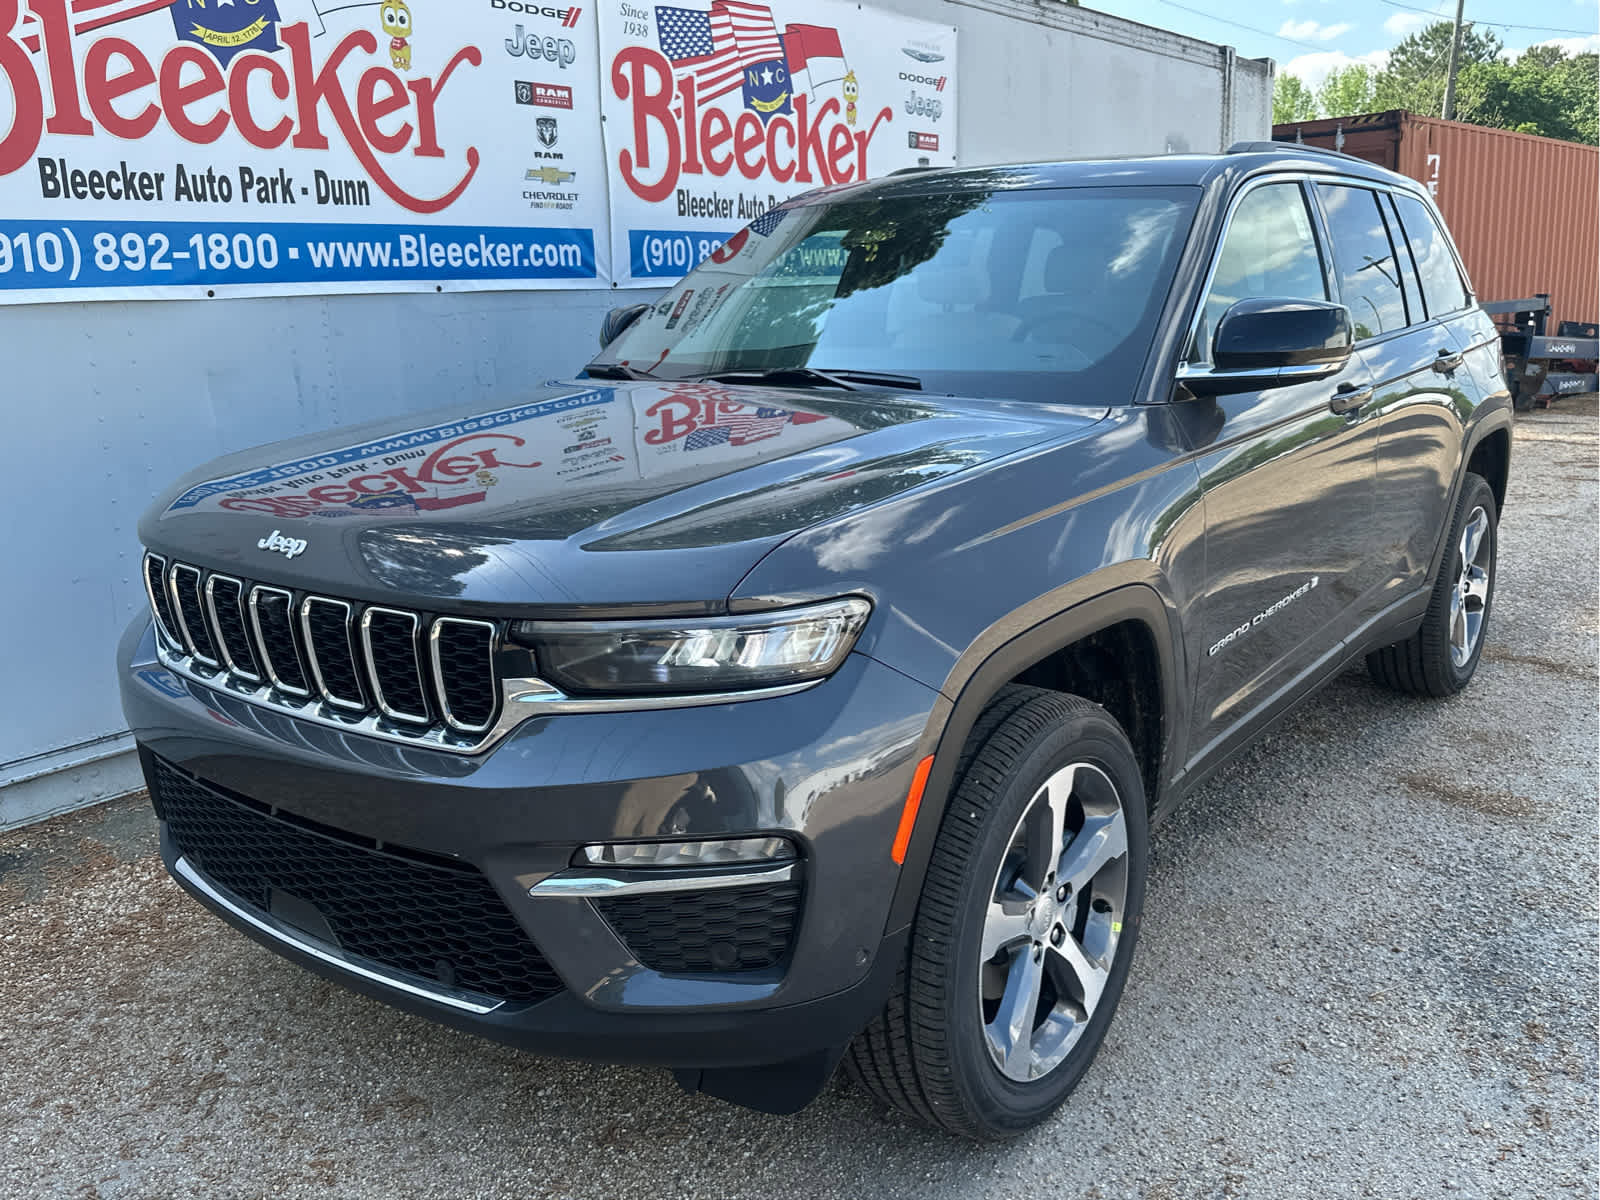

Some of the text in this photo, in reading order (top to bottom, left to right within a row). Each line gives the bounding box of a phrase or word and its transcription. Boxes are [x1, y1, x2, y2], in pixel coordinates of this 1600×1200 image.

[491, 0, 569, 20] DODGE
[620, 3, 649, 20] Since
[206, 32, 231, 44] APRIL
[623, 21, 649, 37] 1938
[505, 24, 575, 69] Jeep
[748, 68, 785, 87] N C
[898, 72, 940, 86] DODGE
[536, 87, 569, 99] RAM
[904, 90, 943, 122] Jeep
[611, 46, 893, 203] Bleecker
[534, 151, 564, 160] RAM
[38, 157, 371, 206] Bleecker Auto Park Dunn
[522, 191, 579, 201] CHEVROLET
[677, 189, 733, 219] Bleecker
[737, 192, 765, 219] Auto
[0, 227, 582, 281] 910) 892-1800 www.Bleecker.com
[642, 234, 694, 273] (910)
[257, 529, 307, 560] Jeep
[1208, 582, 1310, 657] GRAND CHEROKEE
